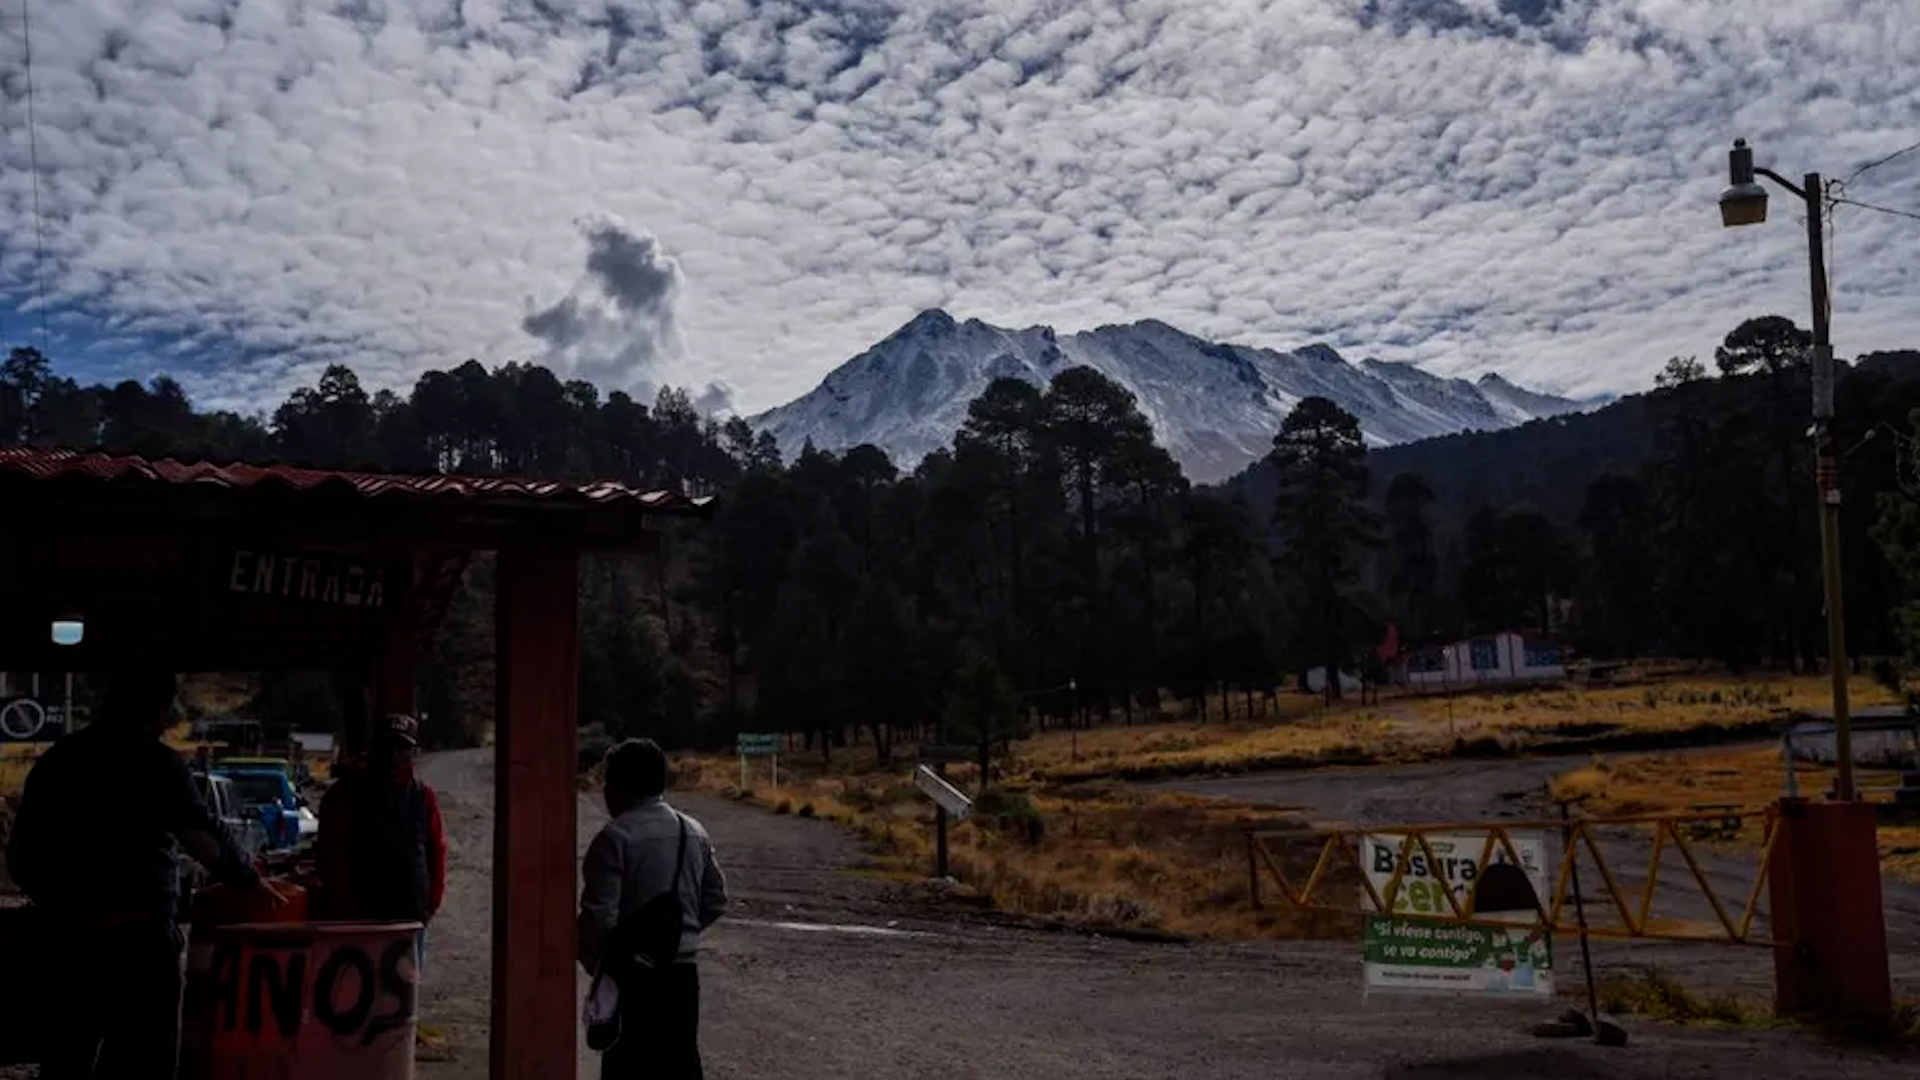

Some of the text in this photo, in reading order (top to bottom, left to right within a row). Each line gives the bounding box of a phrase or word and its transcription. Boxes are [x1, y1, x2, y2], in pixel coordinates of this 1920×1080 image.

[229, 549, 384, 608] ENTRADA
[1393, 921, 1432, 939] viene
[1383, 944, 1397, 957] se
[1399, 945, 1416, 958] va
